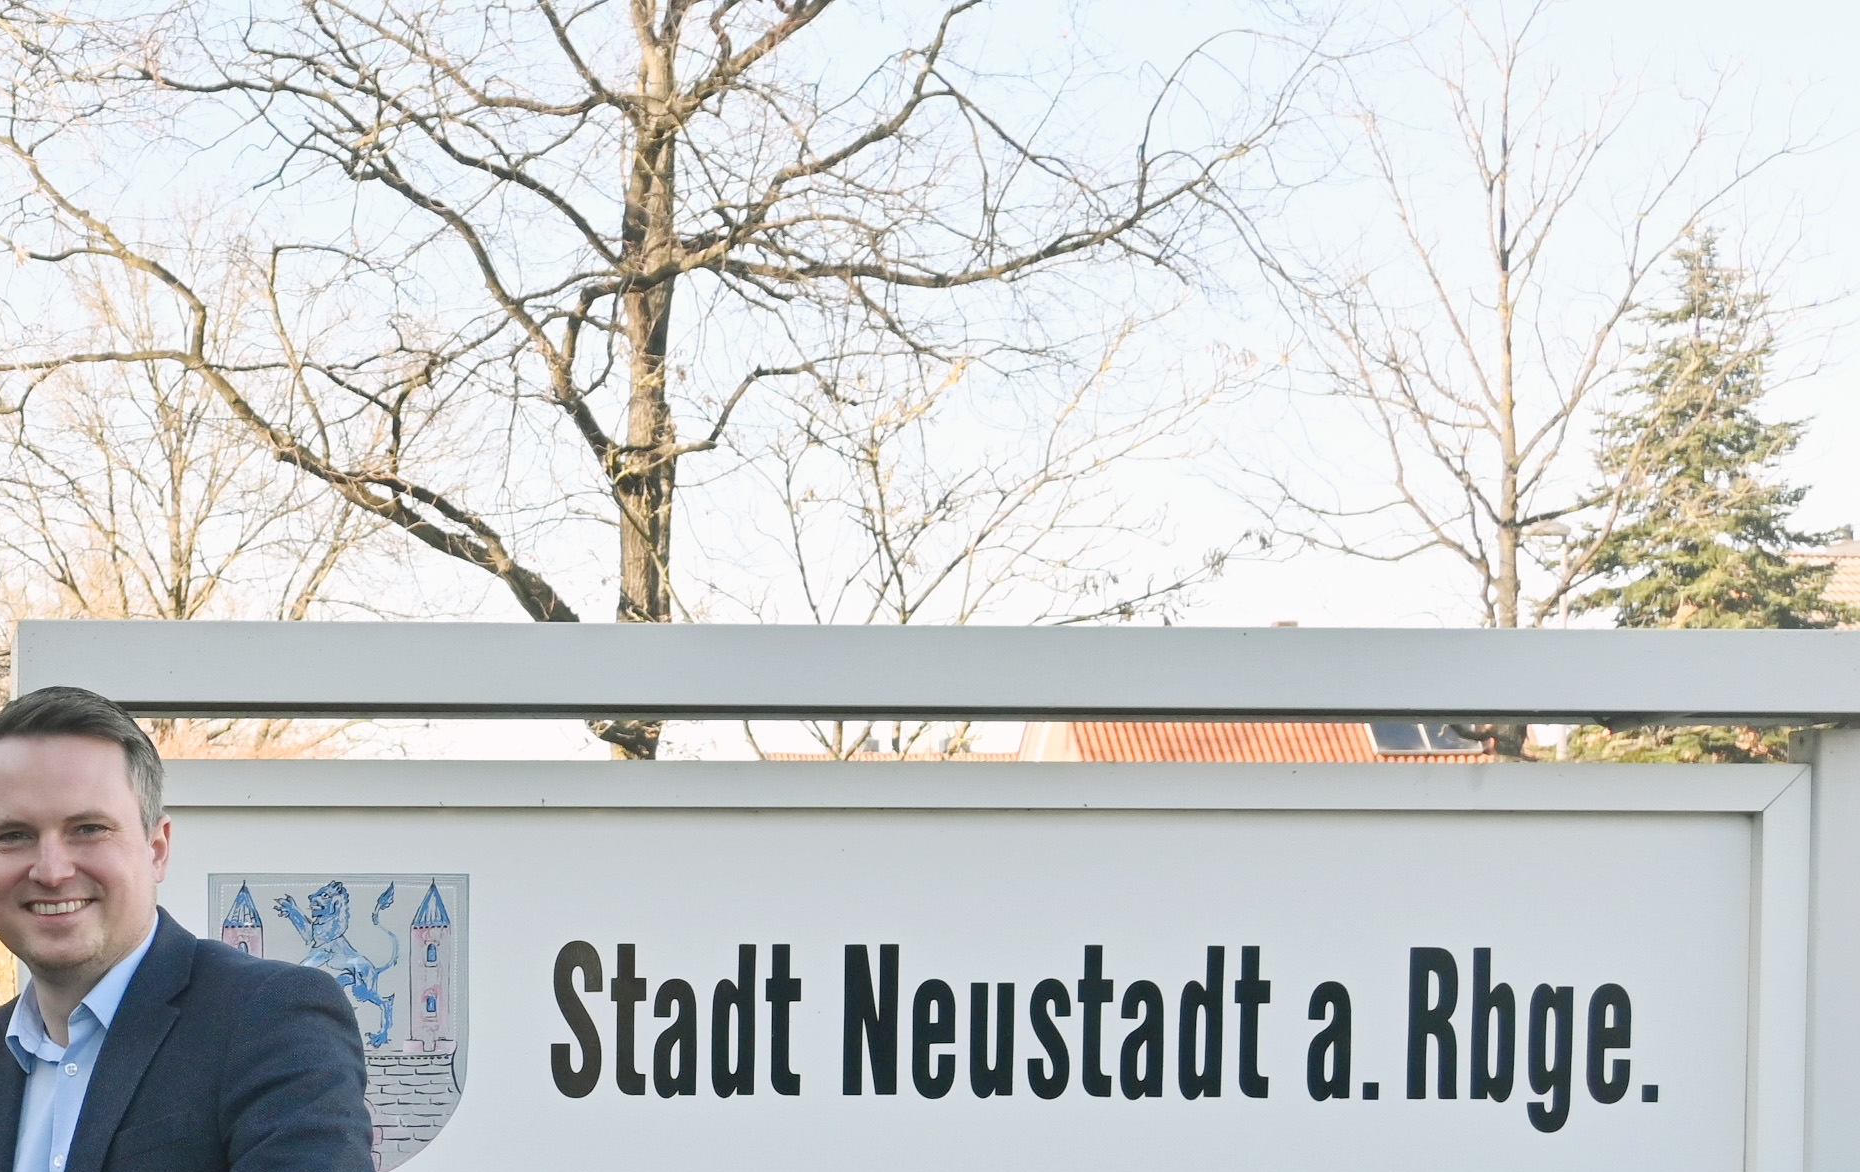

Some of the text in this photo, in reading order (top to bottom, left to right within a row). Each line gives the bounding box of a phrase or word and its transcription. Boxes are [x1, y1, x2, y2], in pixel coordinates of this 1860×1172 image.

[550, 940, 1659, 1134] Stadt Neustadt a. Rbge.
